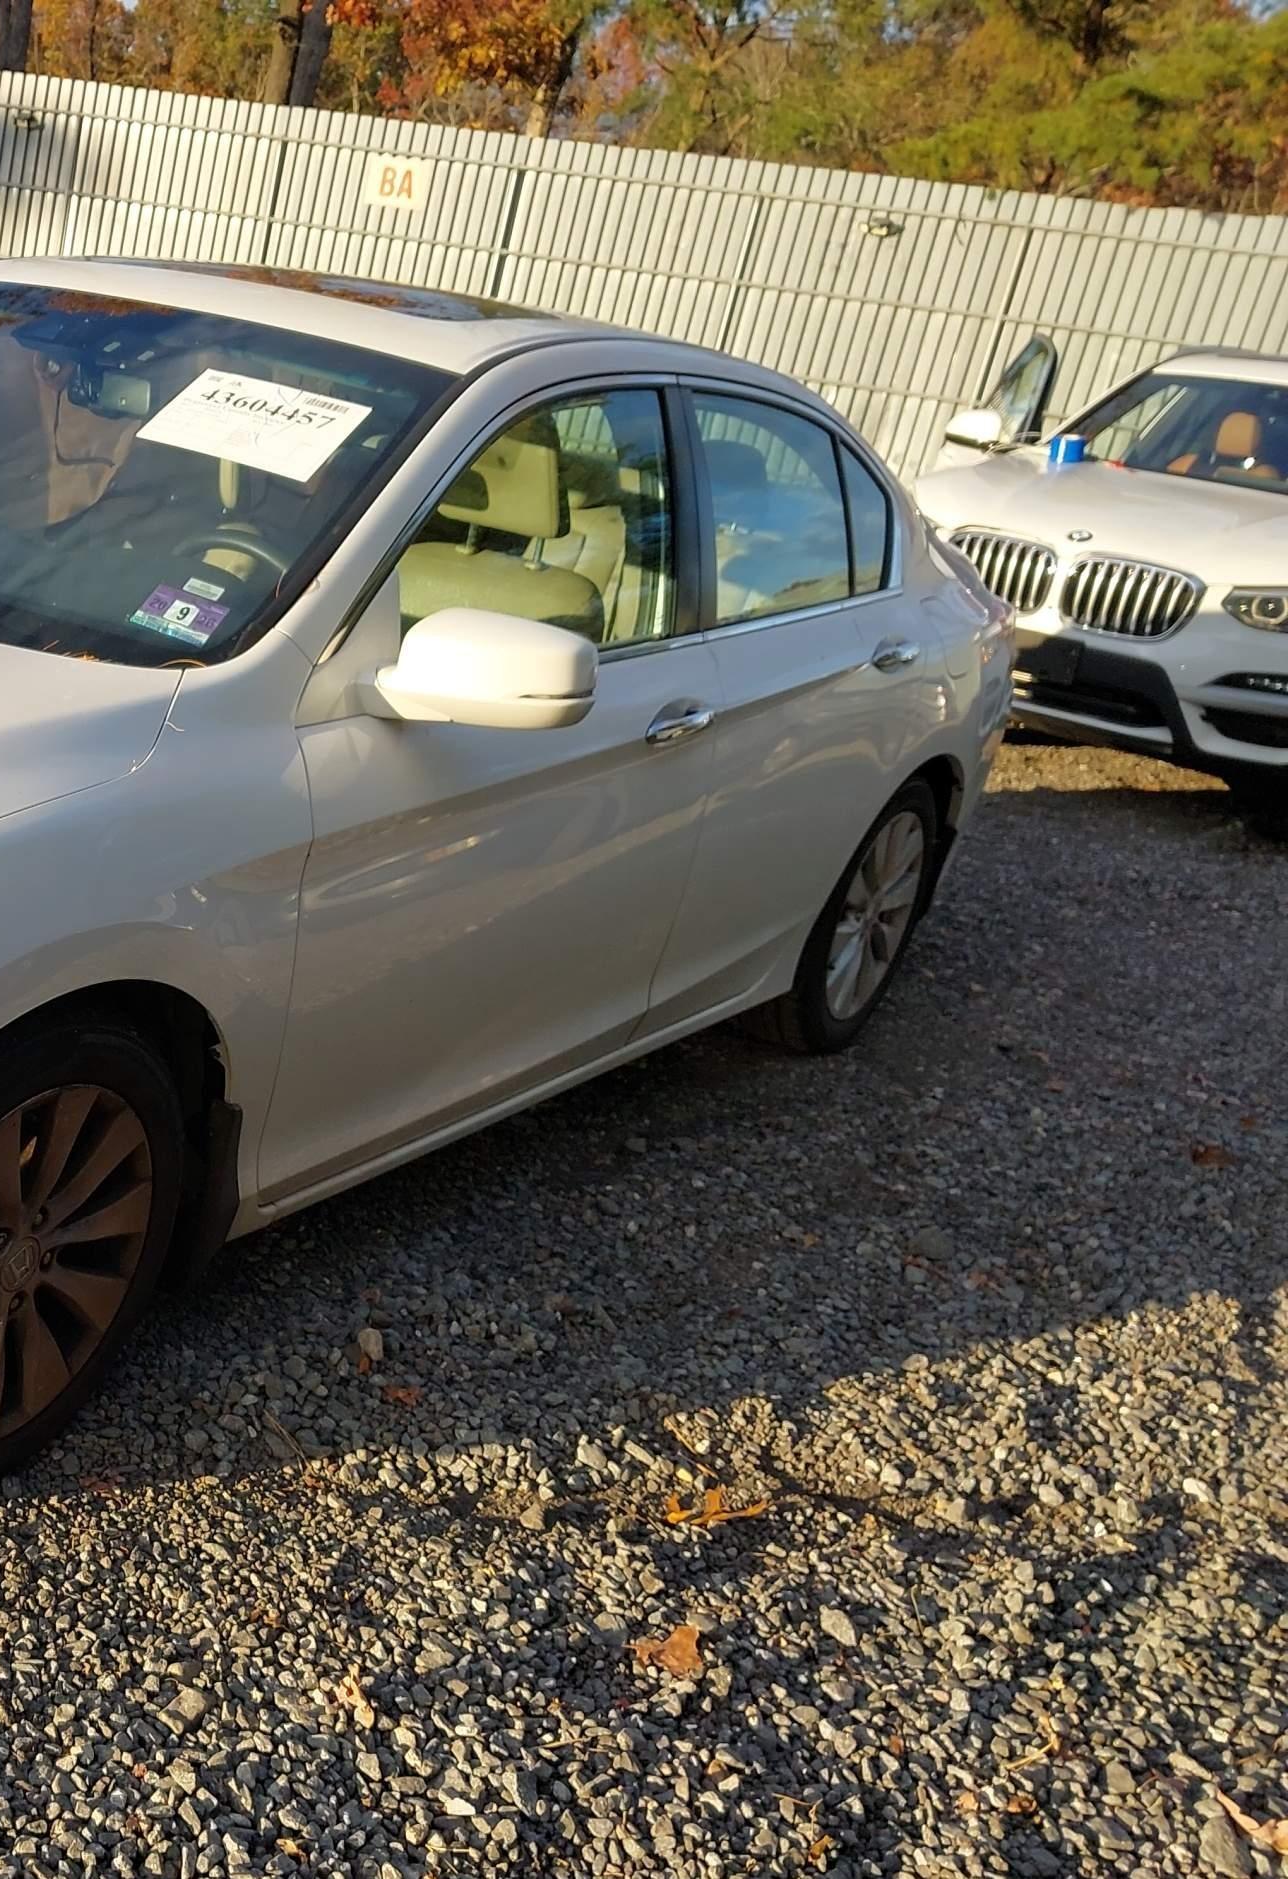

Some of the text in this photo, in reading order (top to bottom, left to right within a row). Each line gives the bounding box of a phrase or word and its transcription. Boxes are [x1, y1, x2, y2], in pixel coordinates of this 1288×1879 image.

[202, 388, 337, 429] 43604457
[149, 598, 168, 610] 20
[176, 606, 190, 621] 9
